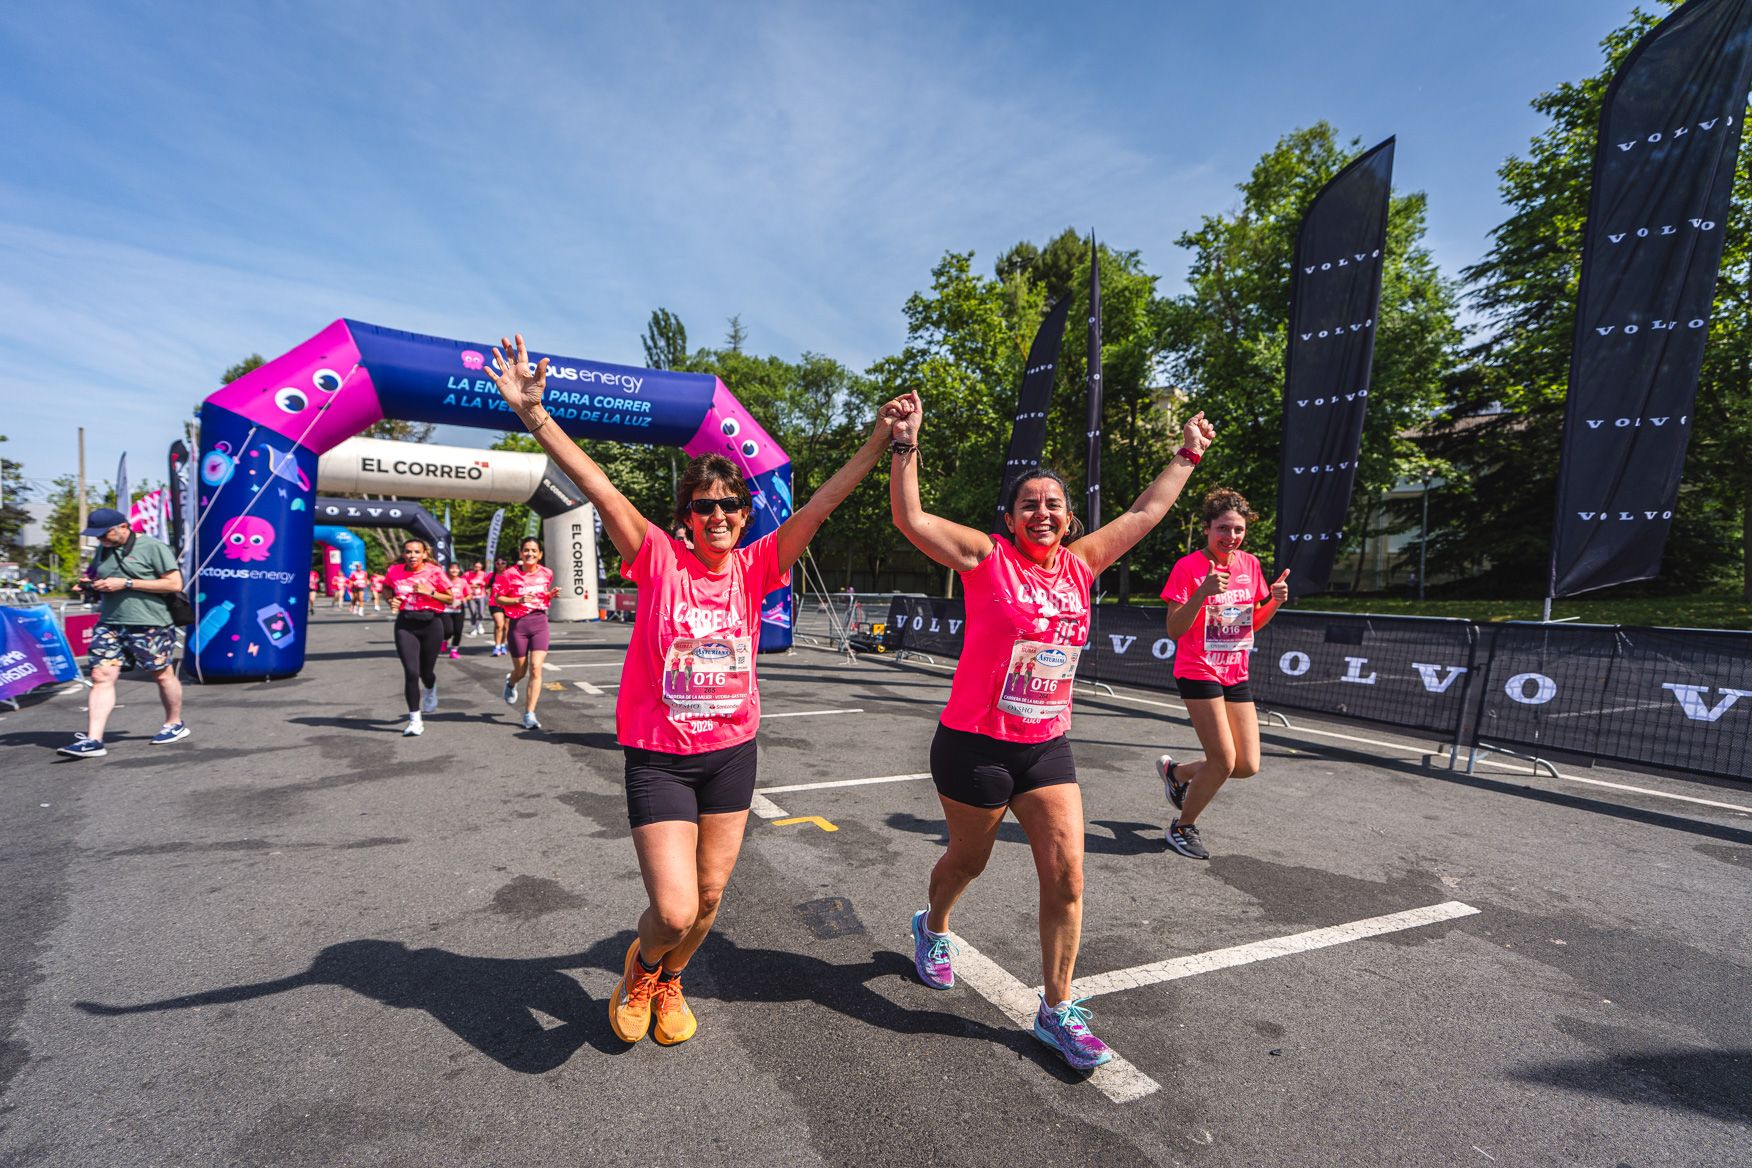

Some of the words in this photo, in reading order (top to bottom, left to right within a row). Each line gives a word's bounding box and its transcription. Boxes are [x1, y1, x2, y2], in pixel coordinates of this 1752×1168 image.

[1607, 218, 1716, 244] VOLVO
[1303, 249, 1380, 275] VOLVO
[1301, 318, 1372, 341] VOLVO
[1027, 363, 1053, 376] OLVO
[578, 369, 644, 394] energy
[447, 376, 470, 391] LA
[549, 389, 590, 406] PARA
[593, 396, 652, 413] CORRER
[443, 394, 457, 406] A
[460, 396, 484, 410] LA
[580, 410, 601, 422] DE
[602, 413, 621, 425] LA
[625, 415, 653, 428] LUZ
[361, 457, 389, 474] EL
[393, 460, 483, 481] CORREO
[314, 505, 402, 518] OLVO
[1578, 511, 1672, 521] VOLVO
[571, 523, 582, 540] EL
[1289, 532, 1343, 542] VOLV
[198, 566, 250, 580] octopus
[249, 569, 296, 585] energy
[572, 541, 585, 596] CORREO
[896, 615, 963, 635] VOLV
[1222, 626, 1240, 634] 016
[693, 672, 726, 686] 016
[1031, 677, 1059, 692] 016
[1253, 648, 1558, 705] OLVO
[691, 720, 713, 734] 2026
